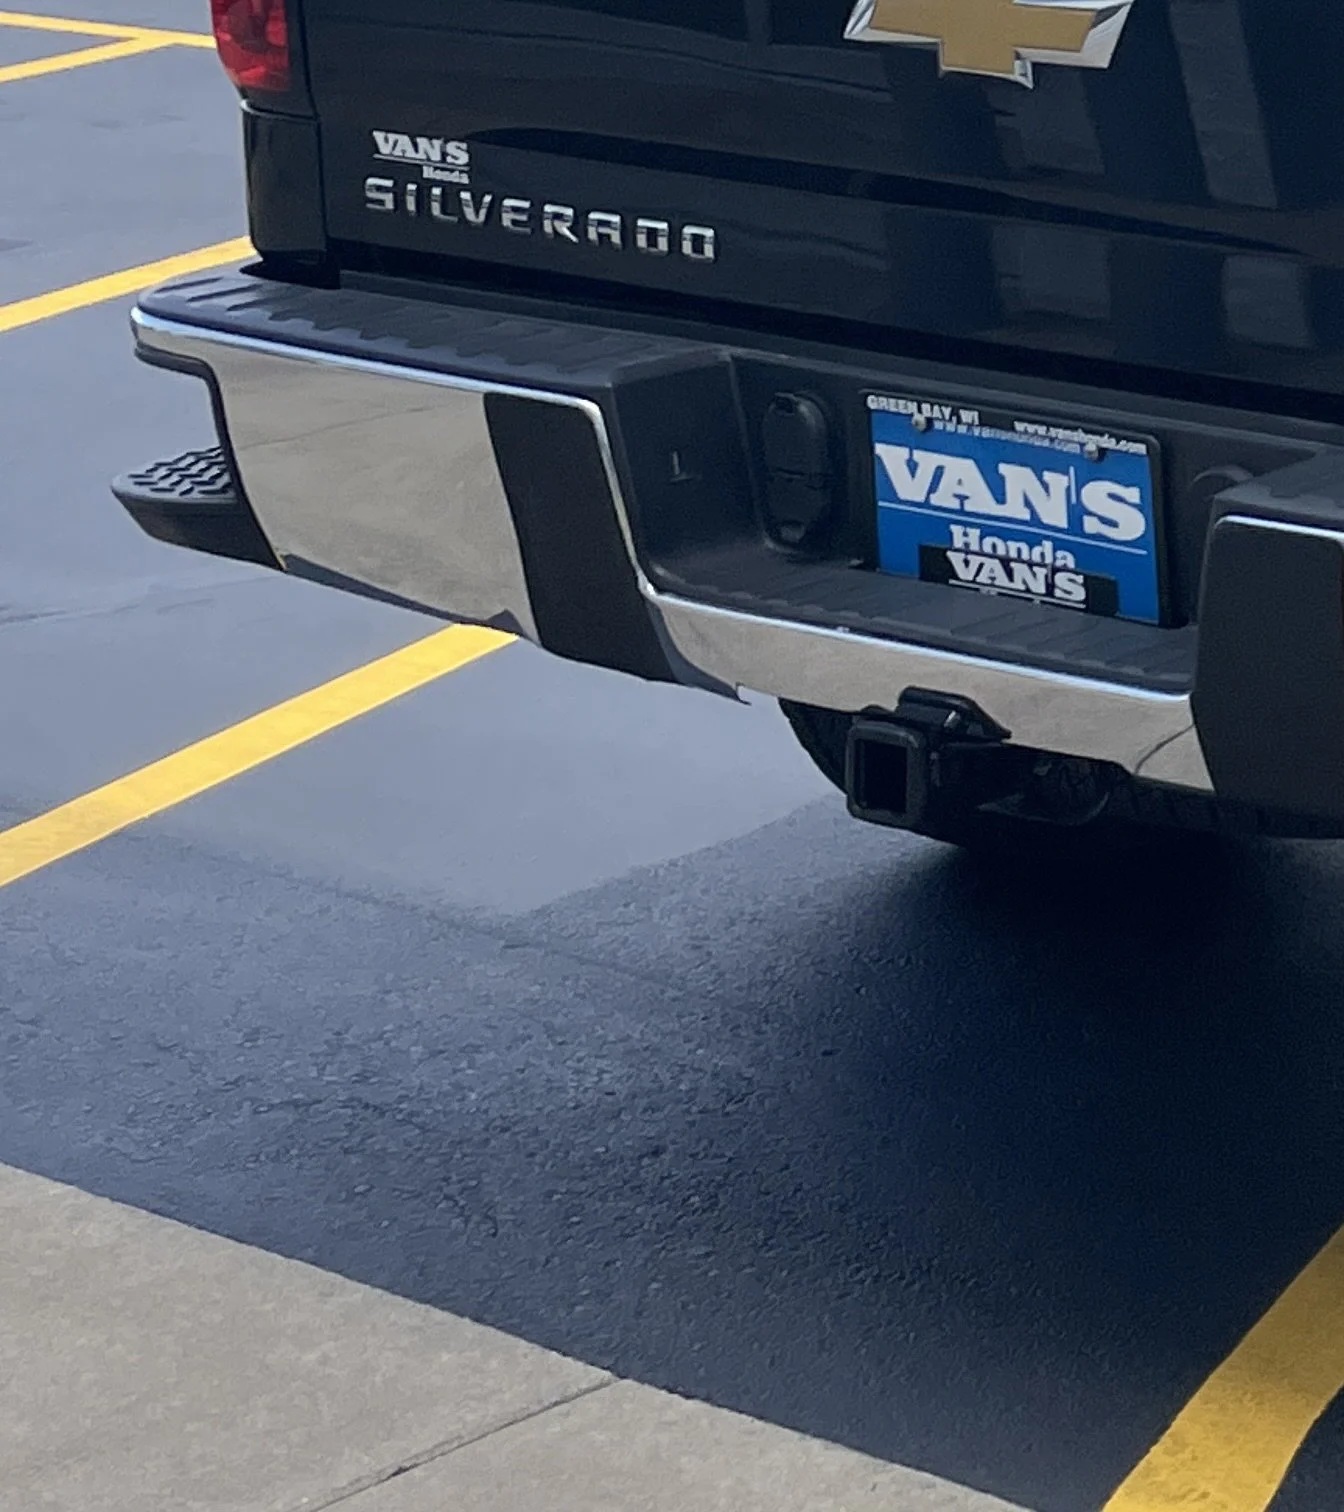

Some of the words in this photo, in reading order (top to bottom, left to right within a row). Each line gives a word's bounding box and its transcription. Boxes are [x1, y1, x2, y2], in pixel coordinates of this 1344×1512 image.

[364, 176, 716, 264] SILVERADO
[866, 394, 918, 415] GREEN
[959, 408, 980, 426] WI
[949, 523, 1077, 570] Honda
